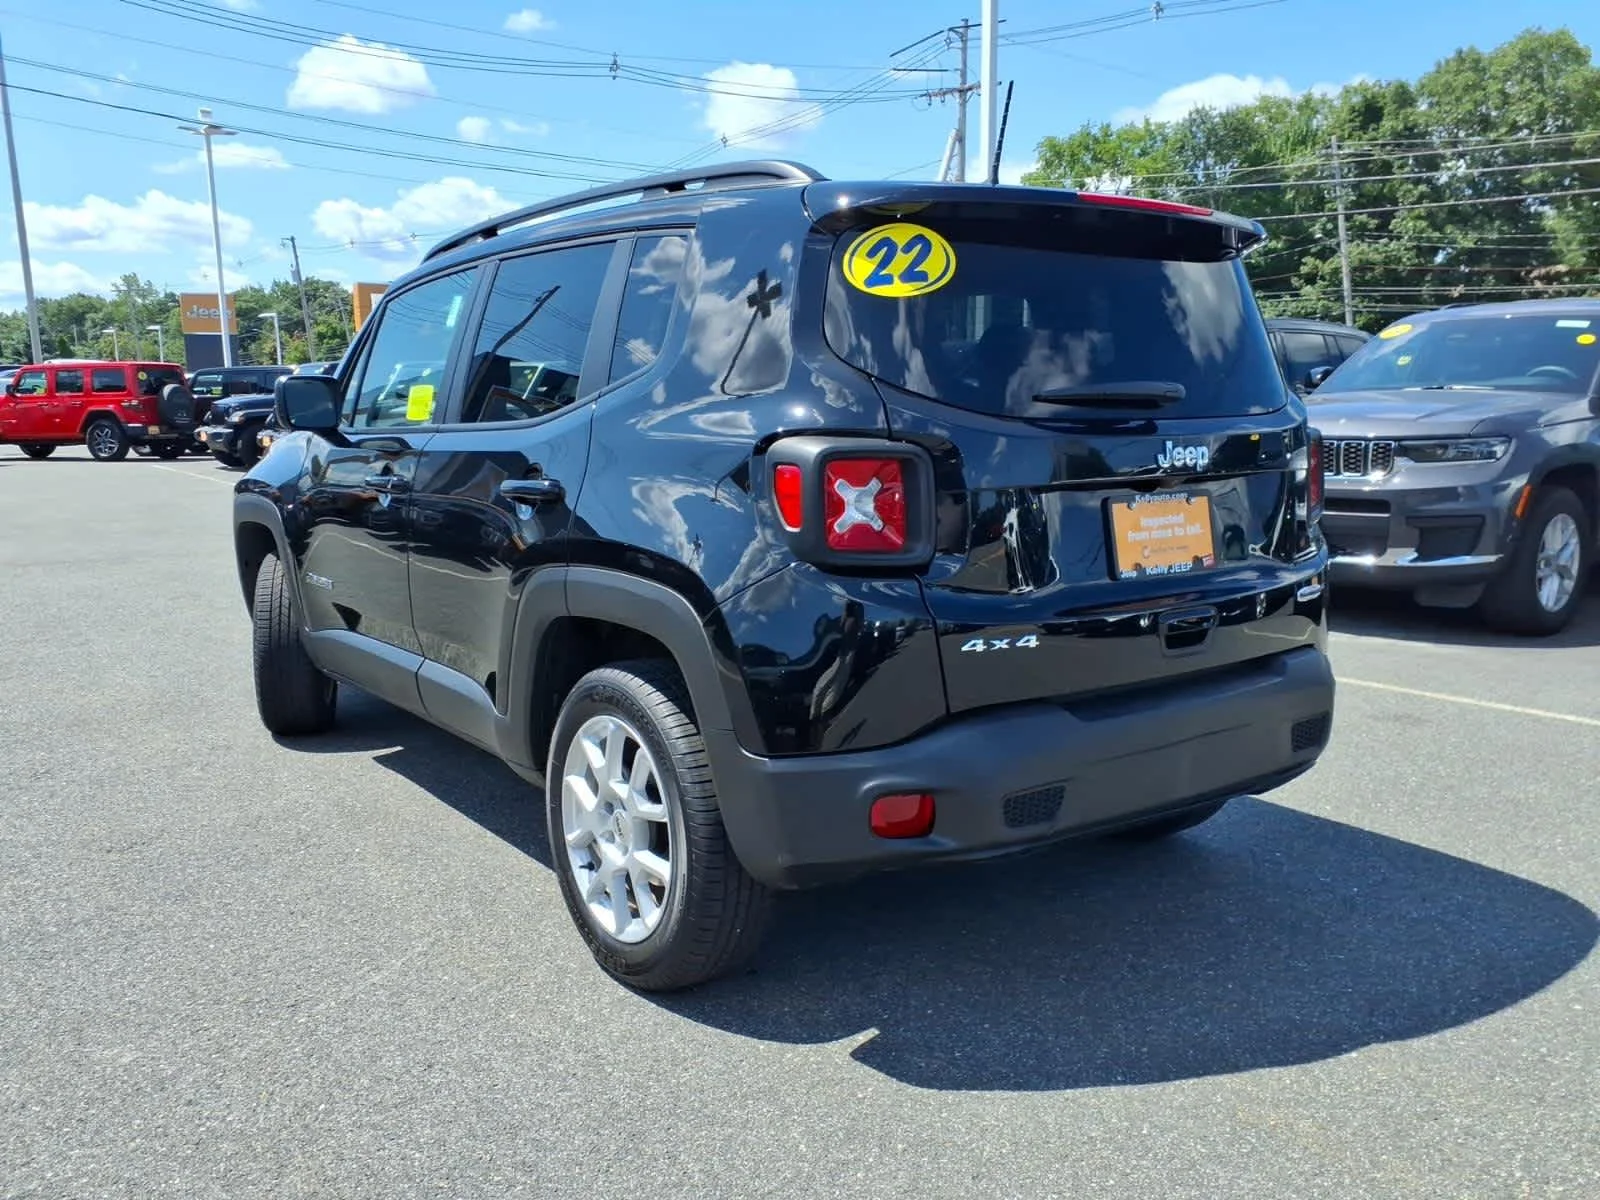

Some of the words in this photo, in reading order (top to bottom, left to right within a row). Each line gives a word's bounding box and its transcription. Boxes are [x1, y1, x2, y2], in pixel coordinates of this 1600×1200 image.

[864, 234, 933, 288] 22
[1157, 440, 1209, 472] Jeep
[1169, 560, 1193, 574] JEEP
